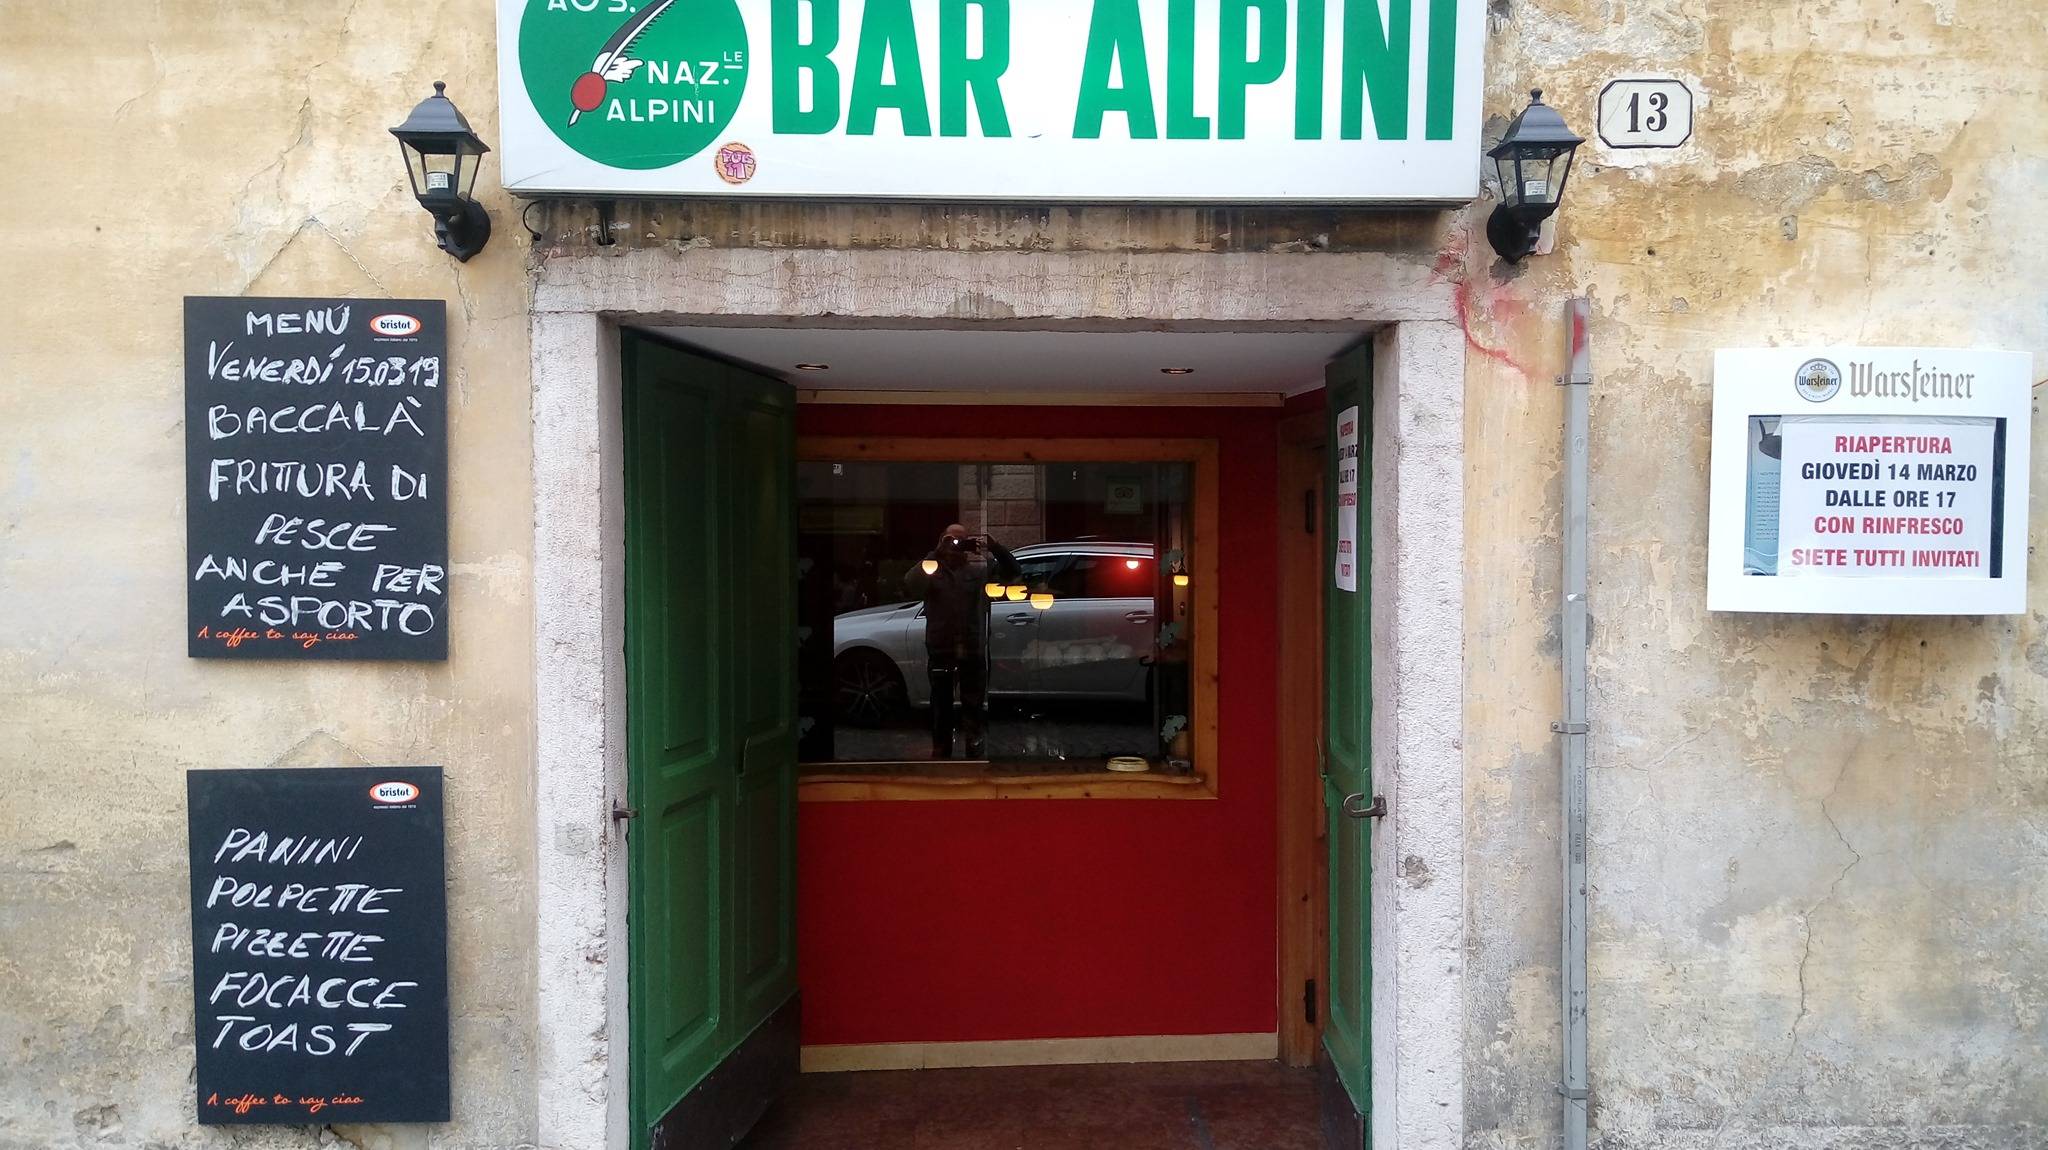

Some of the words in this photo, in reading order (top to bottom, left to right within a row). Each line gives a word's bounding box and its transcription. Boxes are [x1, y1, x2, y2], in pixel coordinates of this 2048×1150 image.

[771, 0, 1011, 138] BAR
[1072, 0, 1457, 140] ALPINI
[606, 97, 715, 124] ALPINI
[1625, 91, 1670, 134] 13
[1798, 373, 1838, 388] Warsteiner
[1848, 358, 1976, 403] Warsteiner
[208, 395, 425, 441] BACCALÀ
[1834, 435, 1953, 455] RIAPERTURA
[208, 459, 375, 502] FRITTURA
[391, 464, 427, 501] DI
[1801, 459, 1881, 481] GIOVEDÌ
[1888, 463, 1910, 481] 14
[1917, 463, 1978, 482] MARZO
[1825, 489, 1886, 508] DALLE
[1893, 491, 1929, 508] ORE
[1936, 491, 1956, 508] 17
[254, 513, 397, 551] PESCE
[1813, 516, 1855, 535] CON
[1861, 517, 1964, 535] RINFRESCO
[195, 554, 346, 587] ANCHE
[371, 564, 445, 596] PER
[1791, 548, 1848, 567] SIETE
[1854, 549, 1906, 568] TUTTI
[1912, 550, 1980, 568] INVITATI
[220, 593, 435, 636] ASPORTO
[215, 627, 260, 648] coffee
[265, 628, 285, 639] to
[292, 631, 321, 648] say
[325, 629, 358, 640] ciao
[213, 828, 363, 866] PANINI
[206, 874, 404, 915] POLPETTE
[209, 971, 419, 1010] FOCACCE
[212, 1015, 393, 1057] TOAST
[224, 1093, 267, 1114] coffee
[273, 1094, 292, 1105] to
[299, 1096, 328, 1113] say
[331, 1092, 363, 1105] ciao
